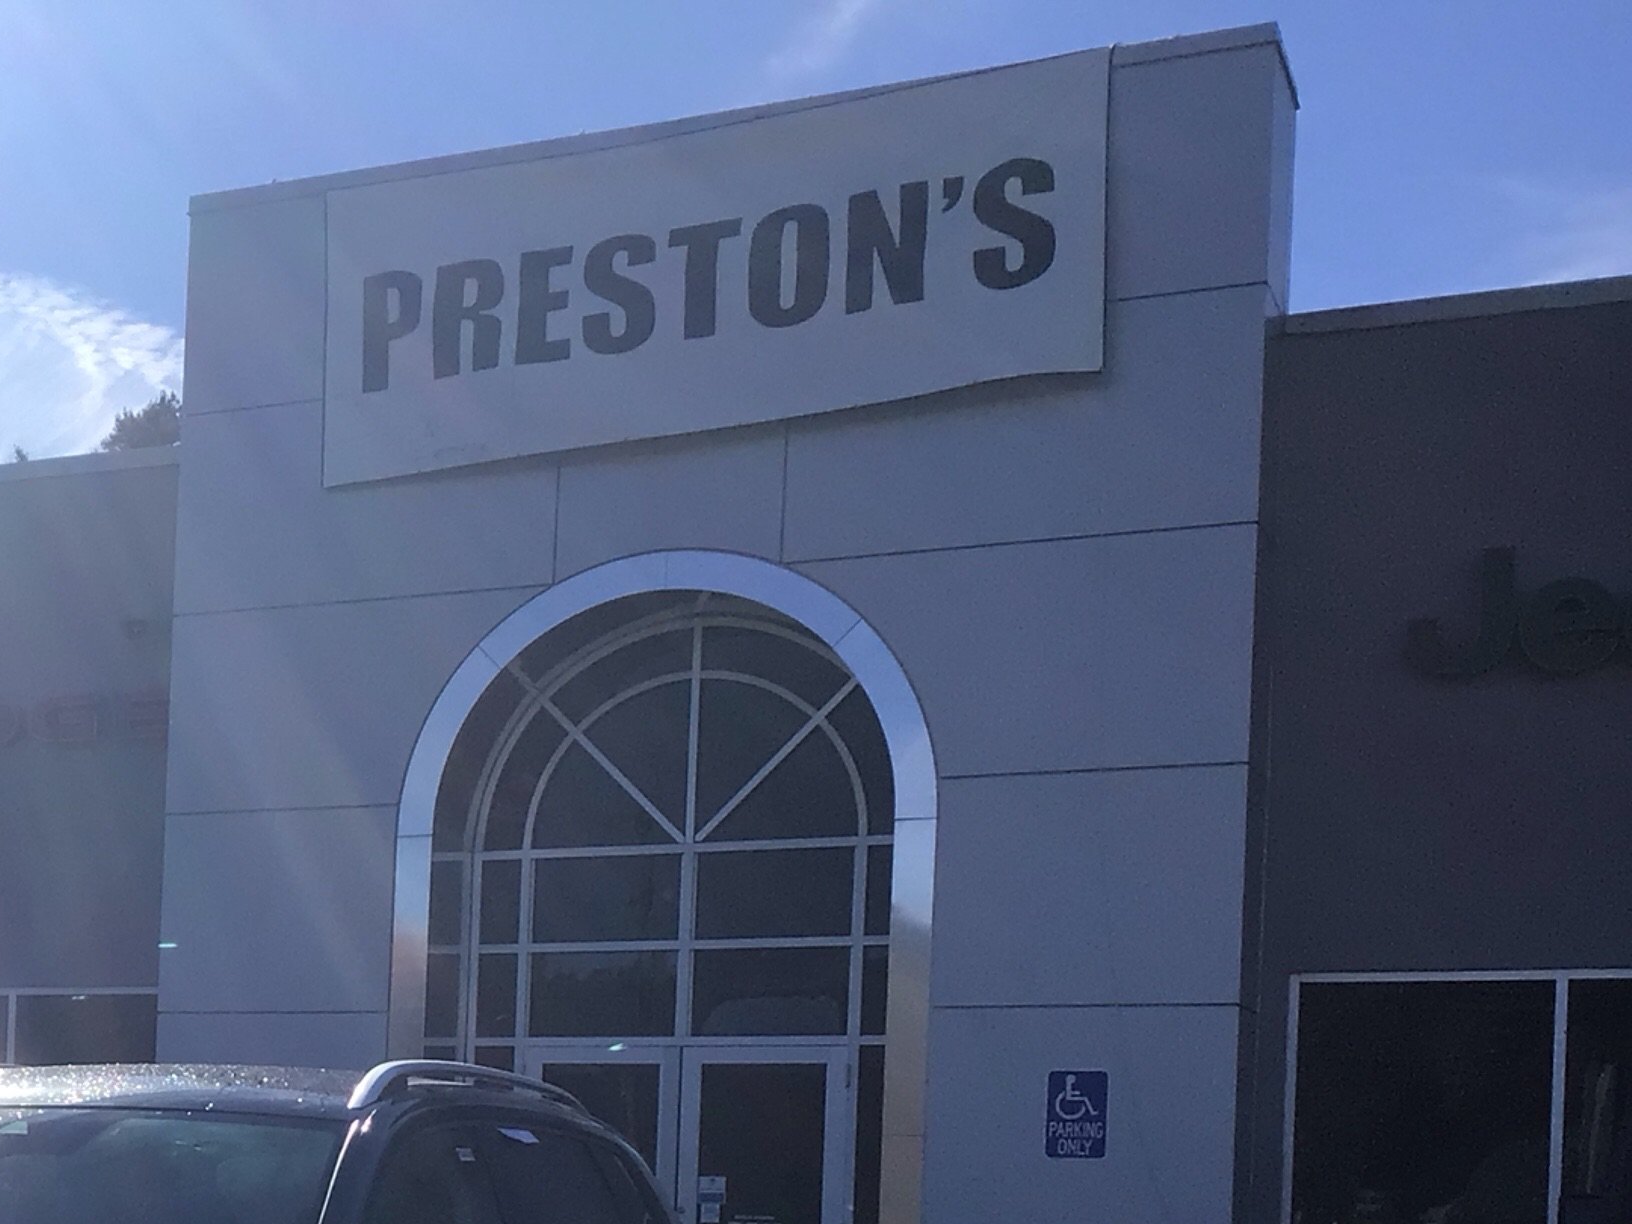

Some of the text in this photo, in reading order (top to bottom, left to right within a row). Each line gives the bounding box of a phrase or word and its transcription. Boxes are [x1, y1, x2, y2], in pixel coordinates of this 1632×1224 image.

[361, 156, 1058, 394] PRESTON'S
[1404, 546, 1632, 684] Je
[1049, 1121, 1104, 1138] PARKING
[1057, 1139, 1093, 1156] ONLY
